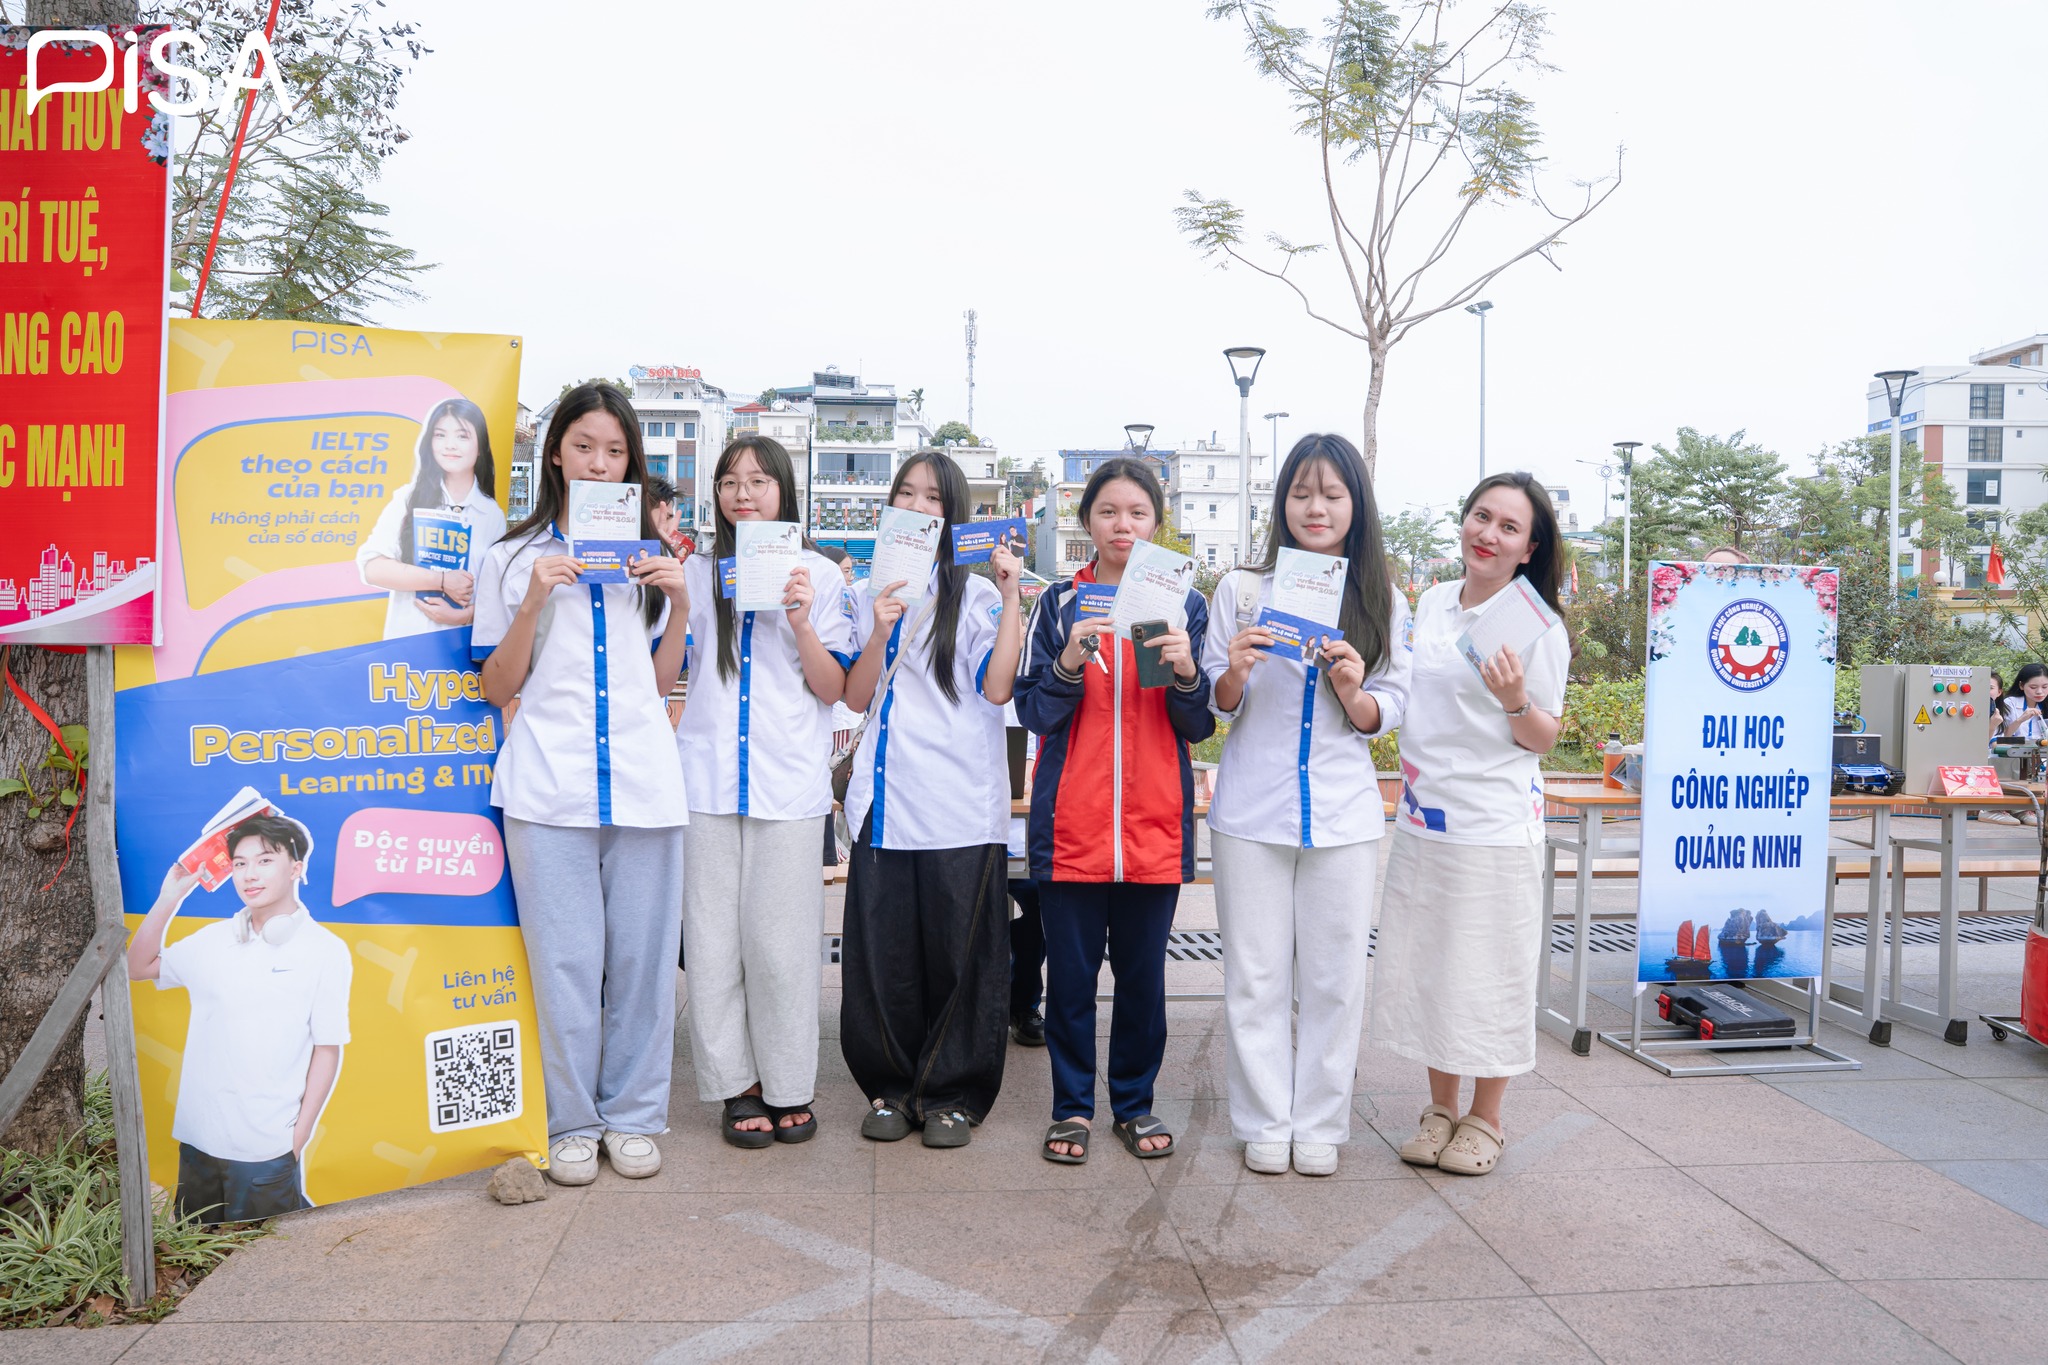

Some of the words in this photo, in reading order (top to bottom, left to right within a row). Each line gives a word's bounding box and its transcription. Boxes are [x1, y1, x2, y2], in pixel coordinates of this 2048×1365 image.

[62, 88, 125, 151] HUY
[40, 186, 108, 276] TUỆ,
[0, 311, 49, 375] NG
[60, 310, 124, 374] CAO
[310, 431, 390, 451] IELTS
[26, 424, 124, 502] MẠNH
[240, 454, 312, 474] theo
[320, 454, 388, 474] cách
[268, 475, 320, 498] của
[328, 479, 384, 505] bạn
[210, 511, 270, 527] Không
[275, 510, 314, 526] phải
[319, 510, 360, 524] cách
[248, 530, 280, 544] của
[286, 528, 308, 544] số
[311, 530, 357, 546] đông
[417, 526, 468, 554] IELTS
[418, 550, 442, 560] PRACTICE
[1724, 604, 1741, 617] CÔNG
[1741, 602, 1763, 612] NGHIỆP
[1777, 625, 1787, 642] NINH
[1719, 668, 1733, 682] NINH
[1731, 678, 1764, 688] UNIVERSITY
[1762, 674, 1771, 683] OF
[1768, 650, 1786, 678] INDUSTRY
[1932, 666, 1942, 675] MÔ
[1943, 667, 1958, 675] HÌNH
[1959, 667, 1967, 676] SỐ
[190, 716, 496, 766] Personalized
[1702, 715, 1736, 756] ĐẠI
[1744, 715, 1784, 756] HỌC
[280, 767, 426, 796] Learning
[434, 766, 455, 787] &
[1671, 768, 1728, 810] CÔNG
[1736, 768, 1809, 816] NGHIỆP
[354, 830, 408, 856] Độc
[418, 833, 494, 858] quyền
[1675, 824, 1745, 874] QUẢNG
[1752, 835, 1802, 868] NINH
[375, 854, 408, 872] từ
[416, 856, 476, 876] PISA
[443, 970, 486, 989] Liên
[492, 965, 515, 986] hệ
[452, 993, 476, 1010] tư
[482, 986, 516, 1006] vấn
